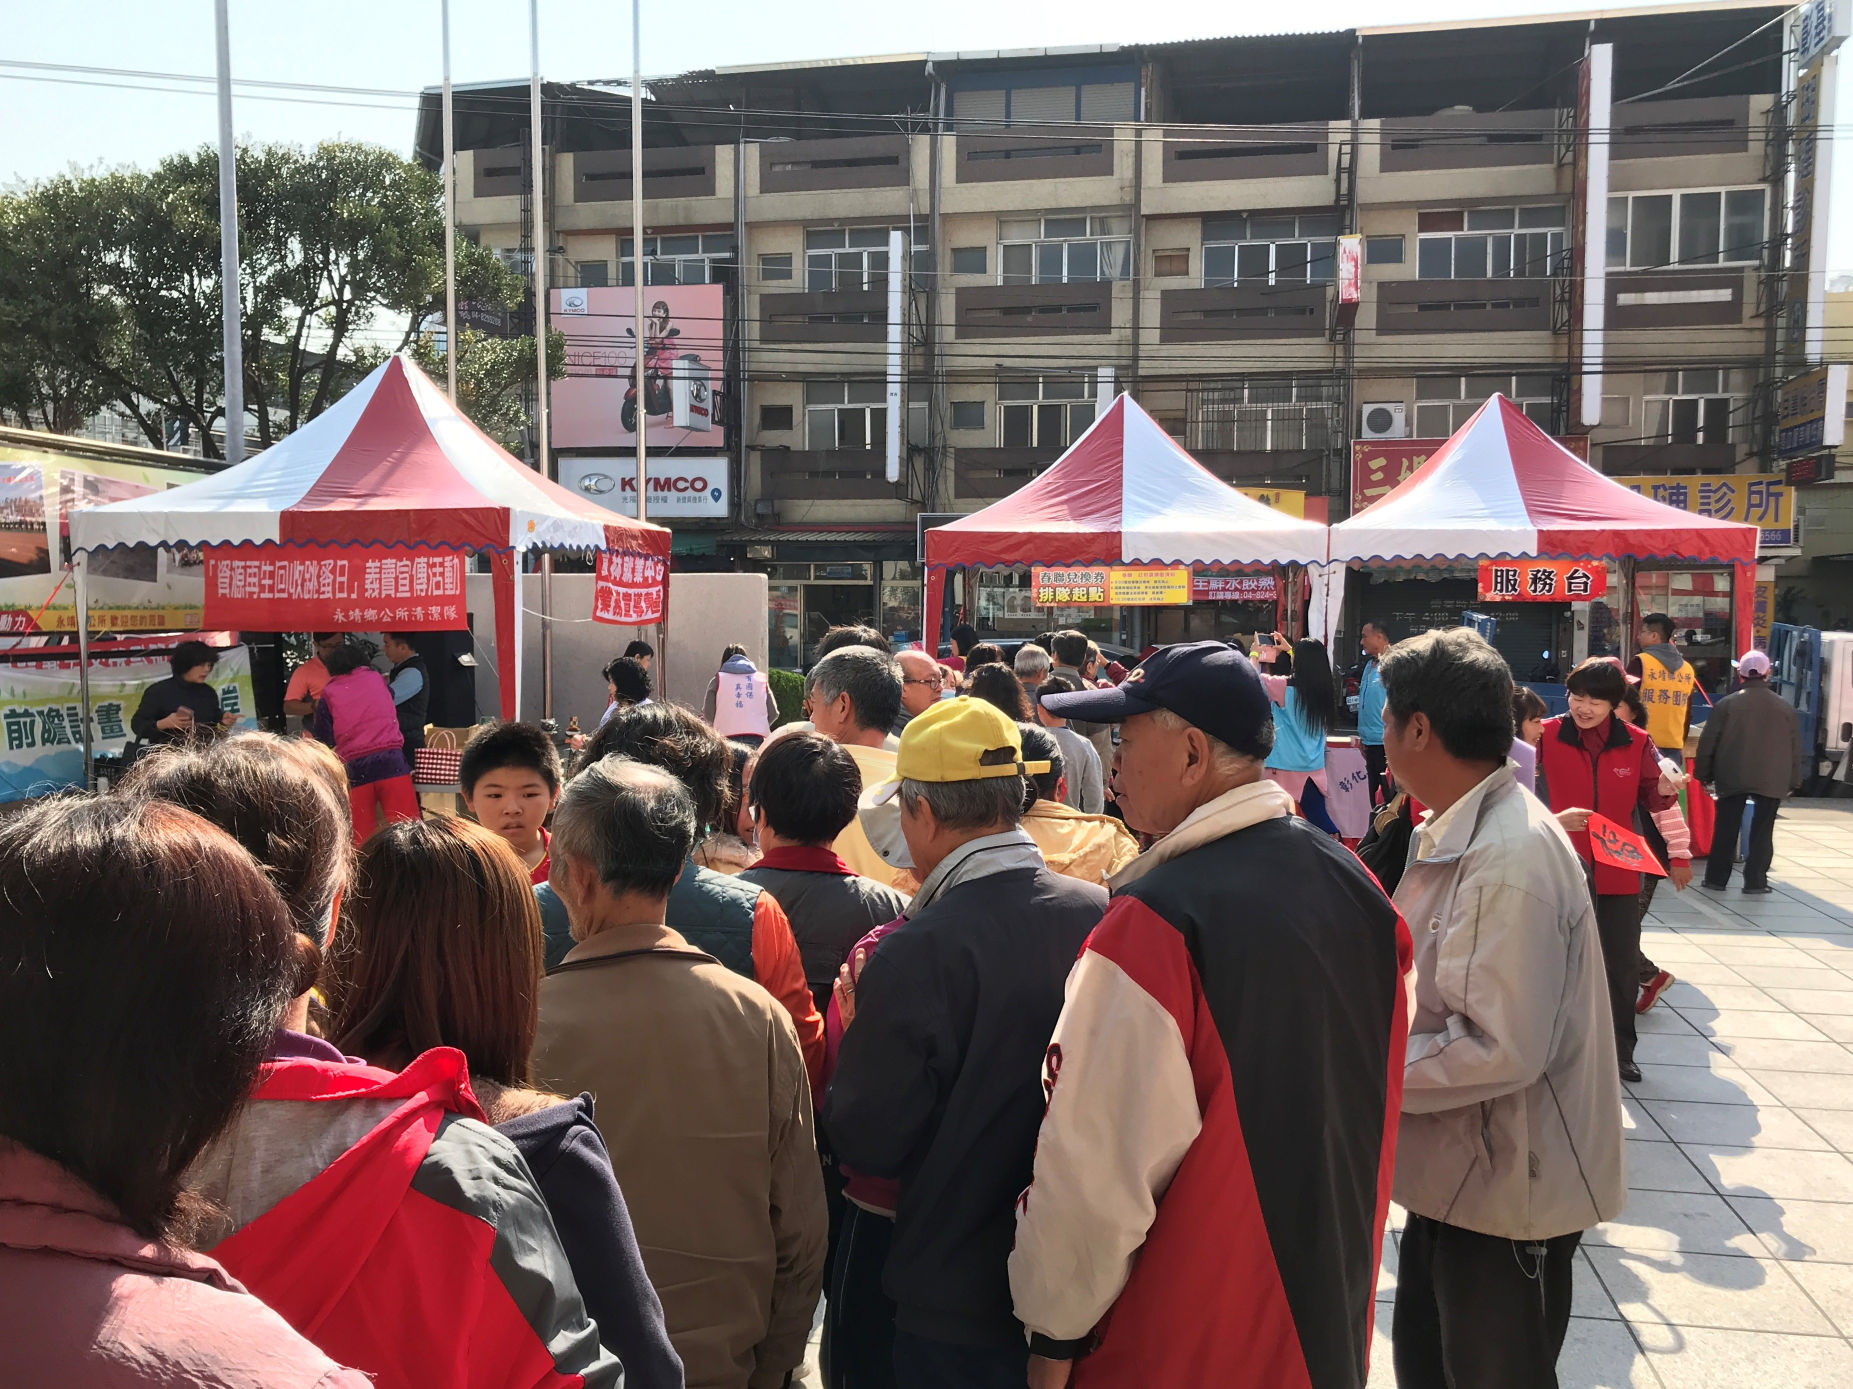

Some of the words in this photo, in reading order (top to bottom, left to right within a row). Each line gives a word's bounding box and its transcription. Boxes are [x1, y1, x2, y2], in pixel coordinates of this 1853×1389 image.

[1040, 571, 1105, 584] 春聯兌換券
[1492, 567, 1593, 595] 服務台
[1038, 586, 1105, 603] 排隊起點
[56, 614, 107, 629] 永靖公所
[332, 606, 459, 624] 永靖鄉公所清潔隊
[3, 702, 127, 751] 前瞻計畫
